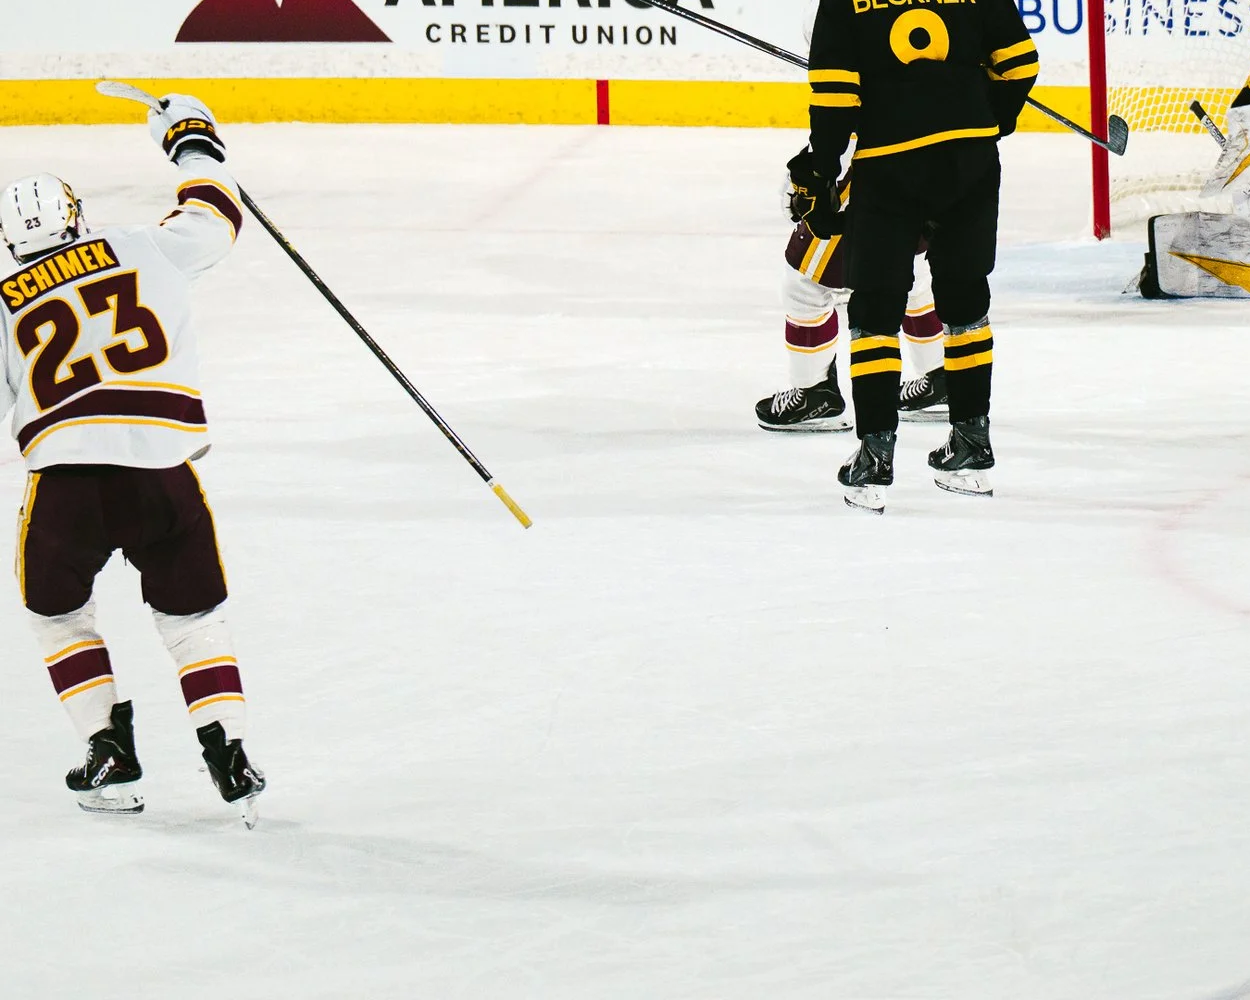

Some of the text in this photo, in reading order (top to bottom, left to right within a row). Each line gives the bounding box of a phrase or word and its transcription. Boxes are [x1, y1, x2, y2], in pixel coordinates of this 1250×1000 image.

[425, 23, 678, 46] CREDIT UNION
[24, 216, 42, 230] 23
[2, 241, 116, 307] SCHIMEK
[13, 268, 170, 414] 23
[90, 756, 115, 788] CCM
